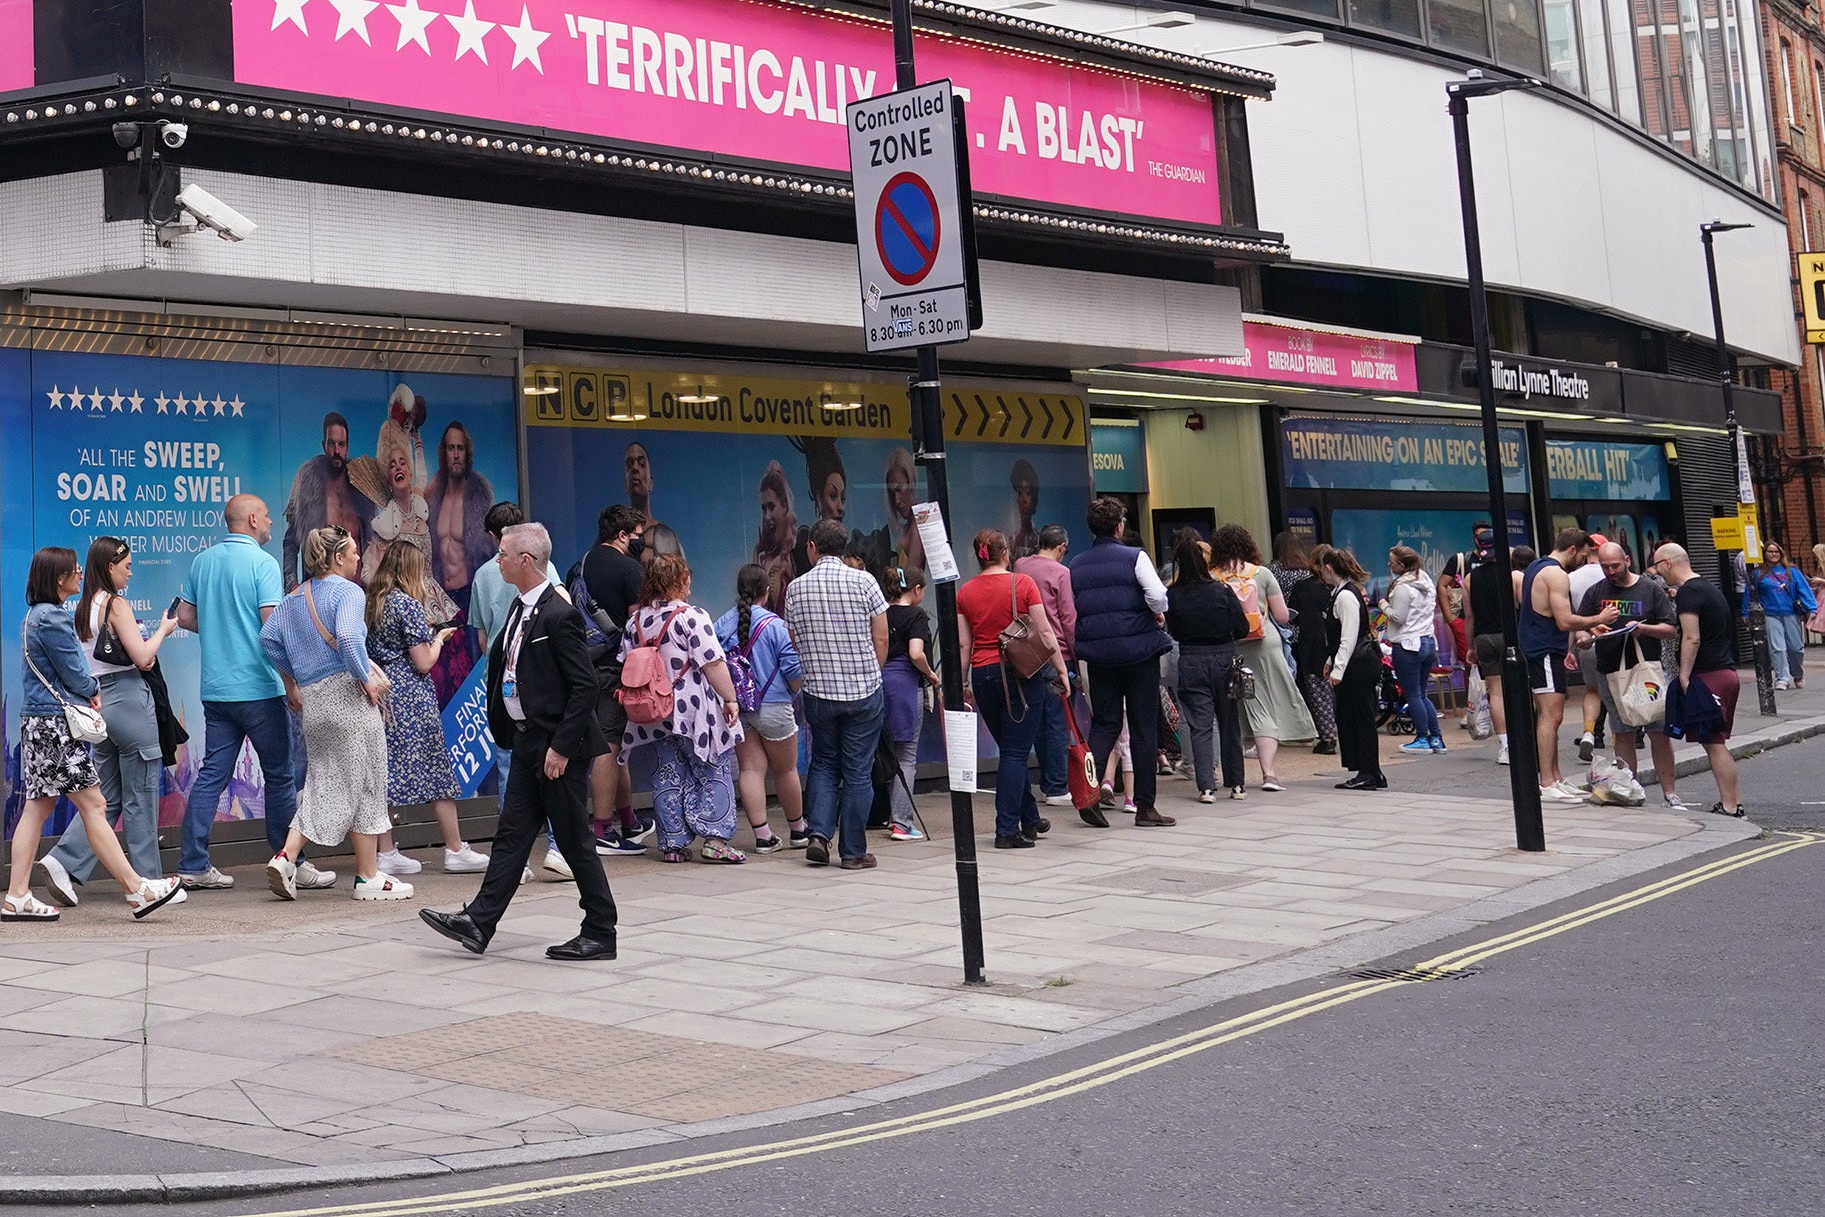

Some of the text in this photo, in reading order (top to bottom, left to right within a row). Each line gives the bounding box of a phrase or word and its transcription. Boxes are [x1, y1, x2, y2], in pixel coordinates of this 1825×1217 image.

[855, 90, 944, 132] Controlled
[869, 127, 933, 168] ZONE
[997, 95, 1027, 155] A
[1034, 101, 1145, 173] BLAST'
[1148, 160, 1206, 184] THE GUARDIAN
[891, 304, 912, 318] Mon
[919, 299, 937, 315] Sat
[870, 325, 894, 342] 8.30
[918, 318, 944, 335] 6.30
[946, 319, 963, 334] pm
[1267, 350, 1305, 372] EMERALD
[1306, 355, 1338, 376] FENNELL
[1351, 359, 1398, 381] DAVID ZIPPEL
[1491, 360, 1589, 400] illian Lynne Theatre
[647, 382, 732, 421] London
[739, 387, 814, 425] Covent
[820, 393, 892, 429] Garden
[110, 449, 135, 467] THE
[144, 440, 225, 472] SWEEP,
[1092, 453, 1125, 470] ESOVA
[1397, 438, 1420, 464] ON
[1424, 438, 1443, 465] AN
[1447, 438, 1476, 466] EPIC
[1479, 439, 1519, 467] SALE'
[1545, 447, 1629, 481] ERBALL HIT'
[57, 472, 126, 502] SOAR
[135, 484, 167, 502] AND
[70, 508, 226, 528] OF AN ANDREW LLOY
[458, 751, 480, 784] 12
